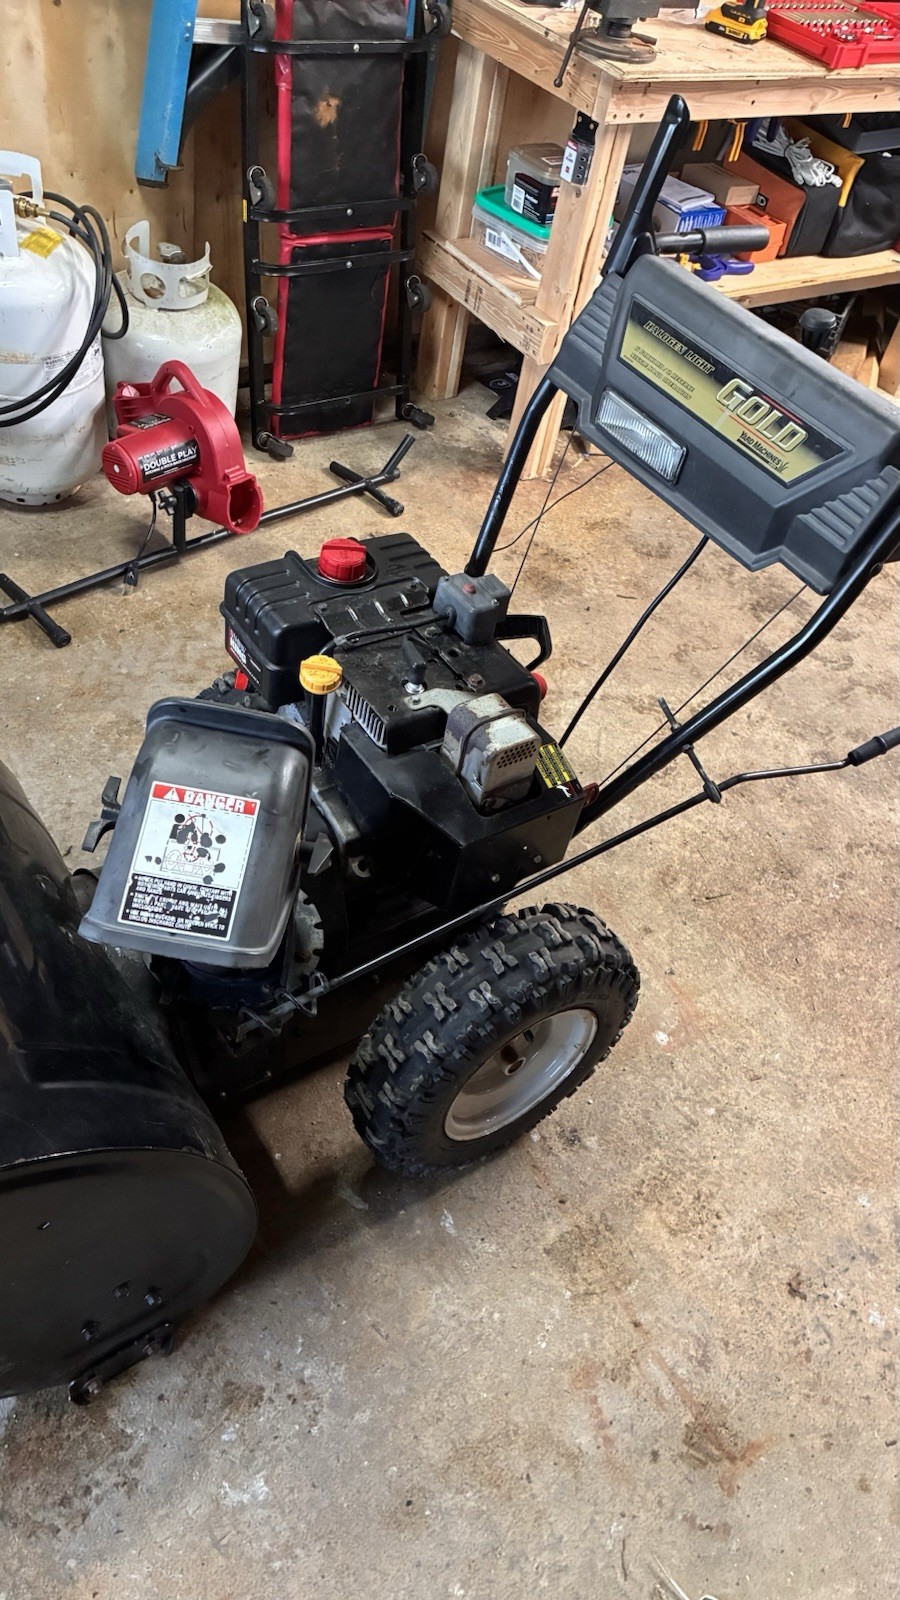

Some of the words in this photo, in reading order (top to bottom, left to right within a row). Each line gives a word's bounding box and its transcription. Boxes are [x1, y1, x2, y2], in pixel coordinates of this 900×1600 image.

[644, 320, 688, 355] HALOGEN
[684, 350, 715, 374] LIGHT
[716, 378, 808, 452] GOLD
[143, 453, 176, 471] DOUBLE
[177, 446, 197, 460] PLAY
[739, 431, 754, 446] YARD
[753, 441, 781, 465] MACHINES
[183, 790, 246, 813] DANGER
